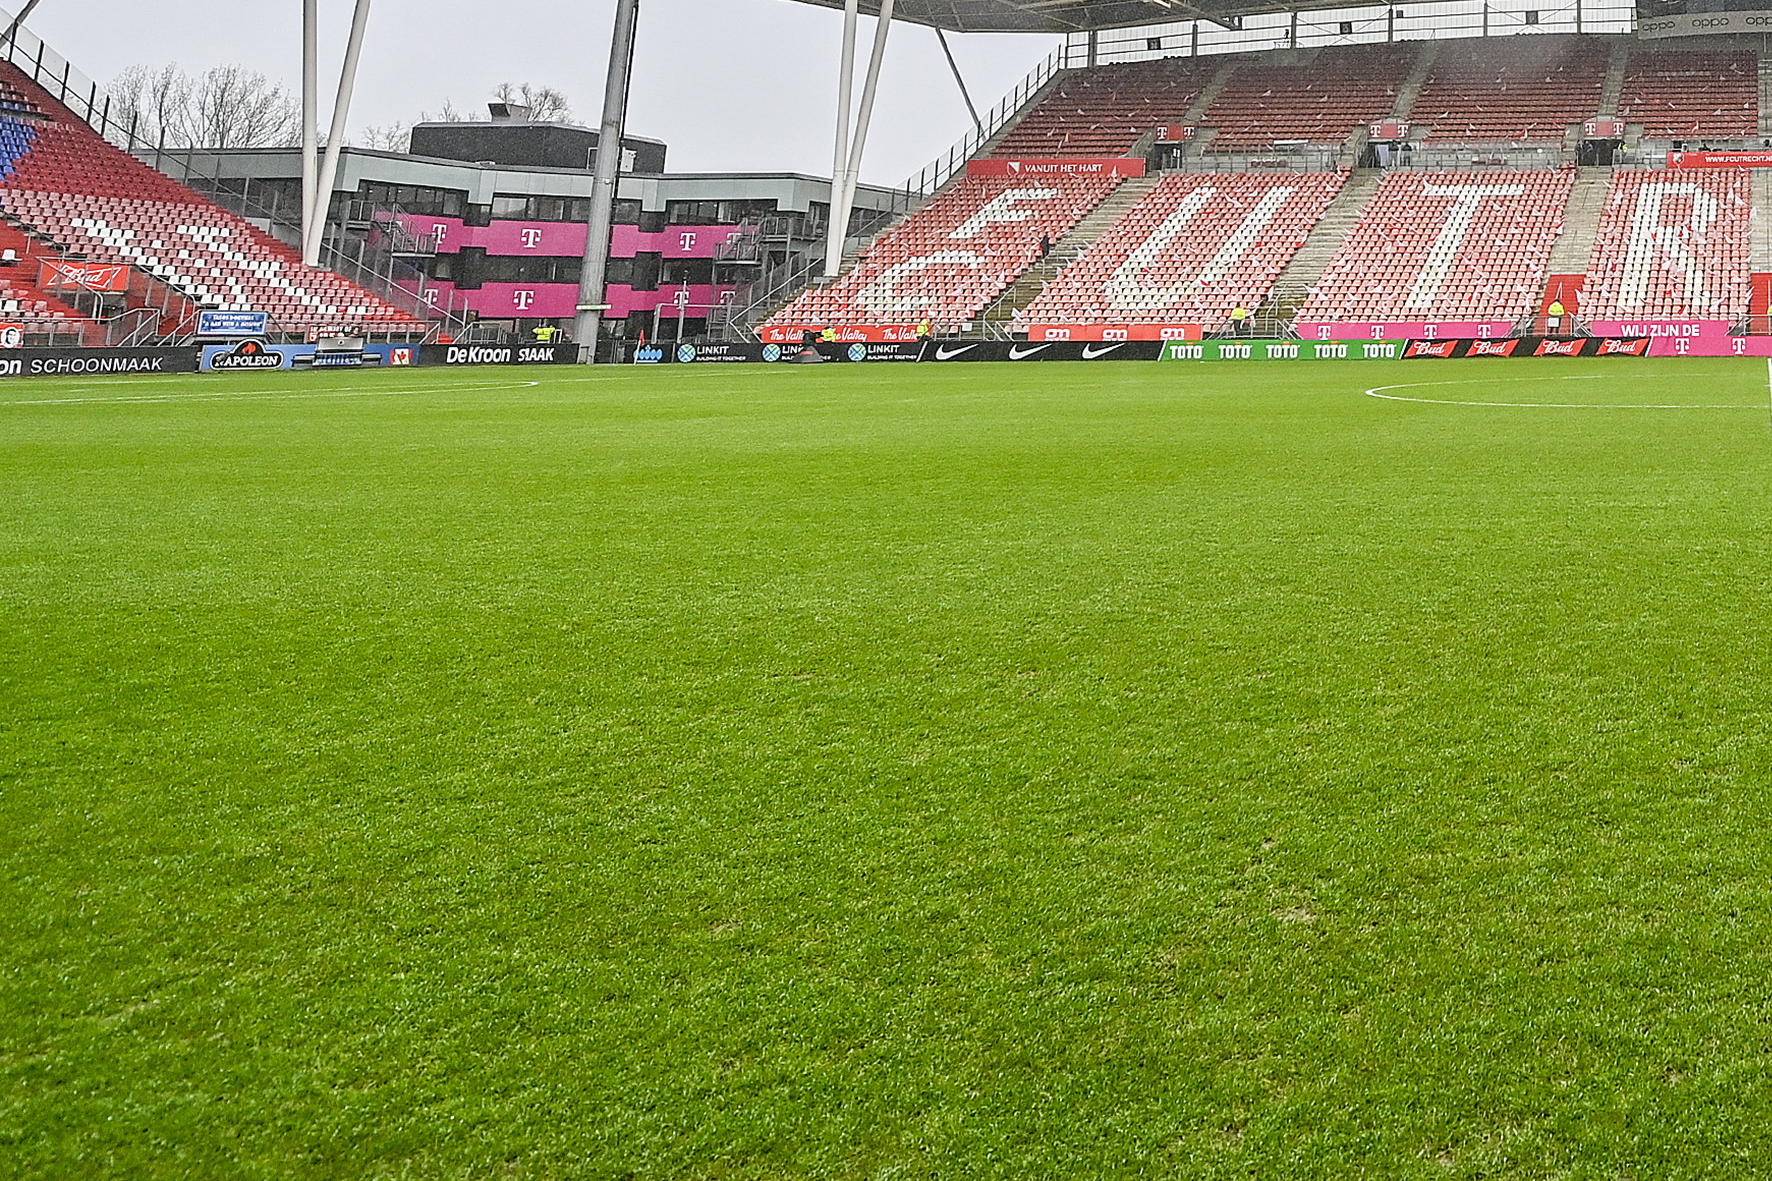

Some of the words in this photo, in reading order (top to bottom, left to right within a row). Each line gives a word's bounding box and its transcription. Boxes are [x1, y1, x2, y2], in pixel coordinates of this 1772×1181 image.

[1642, 21, 1675, 32] oppo
[1692, 18, 1729, 28] oppo
[1025, 164, 1059, 173] VANUIT
[1060, 164, 1076, 173] HET
[1079, 164, 1103, 172] HART
[769, 328, 784, 340] The
[785, 327, 805, 341] Vall
[842, 327, 868, 342] Valley
[882, 328, 898, 340] The
[898, 327, 917, 341] Vall
[1621, 324, 1647, 337] WIJ
[1649, 324, 1679, 337] ZIJN
[1682, 324, 1700, 336] DE
[697, 345, 730, 355] LINKIT
[868, 345, 900, 354] LINKIT
[1169, 345, 1203, 359] TOTO
[1218, 344, 1252, 359] TOTO
[1265, 344, 1300, 359] TOTO
[1314, 344, 1348, 359] TOTO
[1362, 344, 1397, 358] TOTO
[1413, 342, 1447, 355] Bud
[1473, 341, 1507, 354] Bud
[1543, 340, 1575, 354] Bud
[1604, 340, 1637, 353] Bud
[30, 357, 163, 373] SCHOONMAAK
